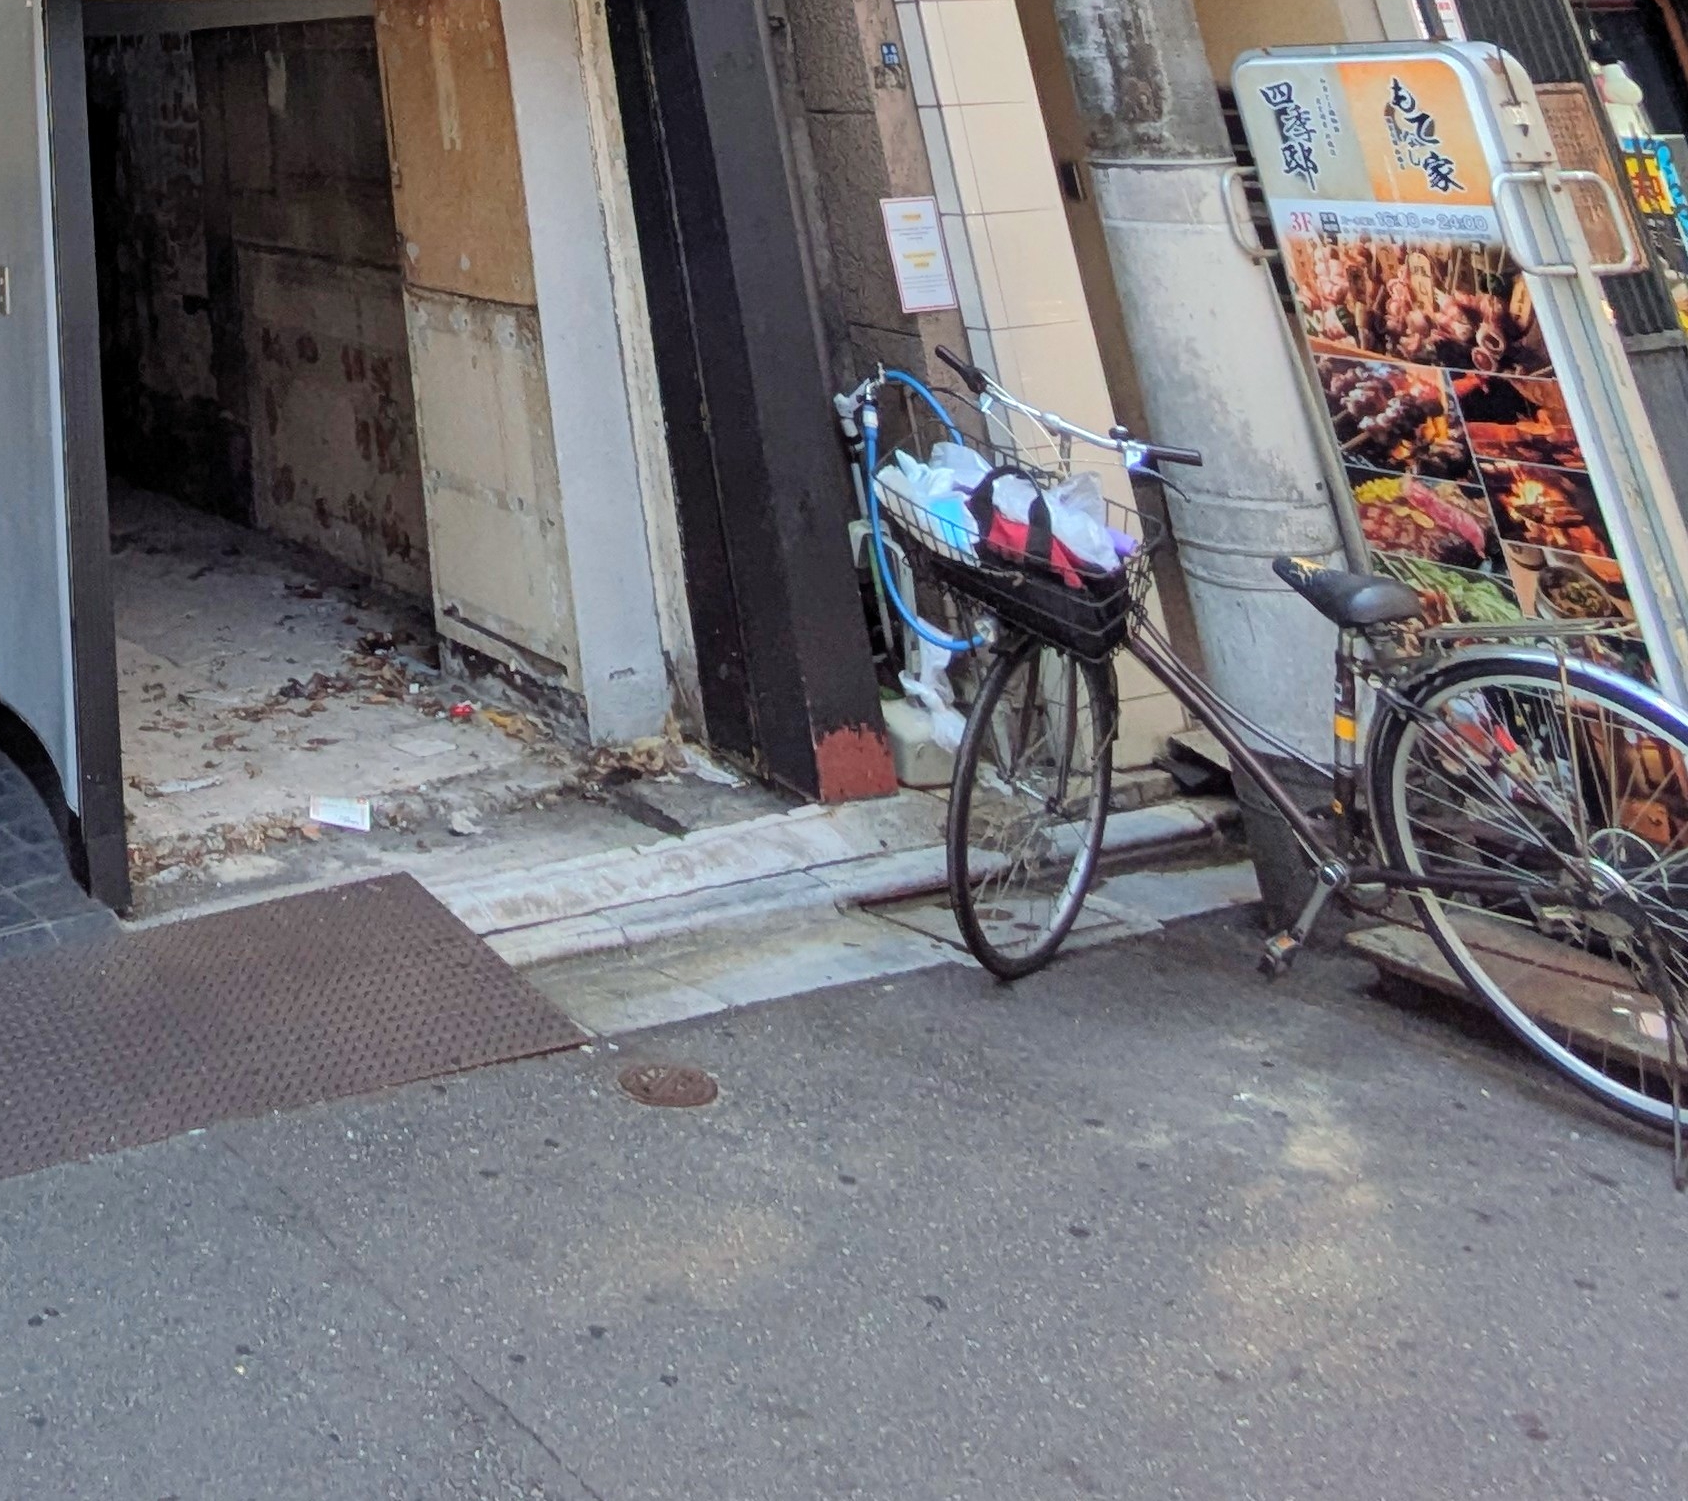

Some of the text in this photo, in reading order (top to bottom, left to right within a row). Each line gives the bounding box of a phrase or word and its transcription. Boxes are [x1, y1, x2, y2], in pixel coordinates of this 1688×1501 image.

[1259, 80, 1319, 192] 四季邸
[1290, 212, 1312, 233] 3F
